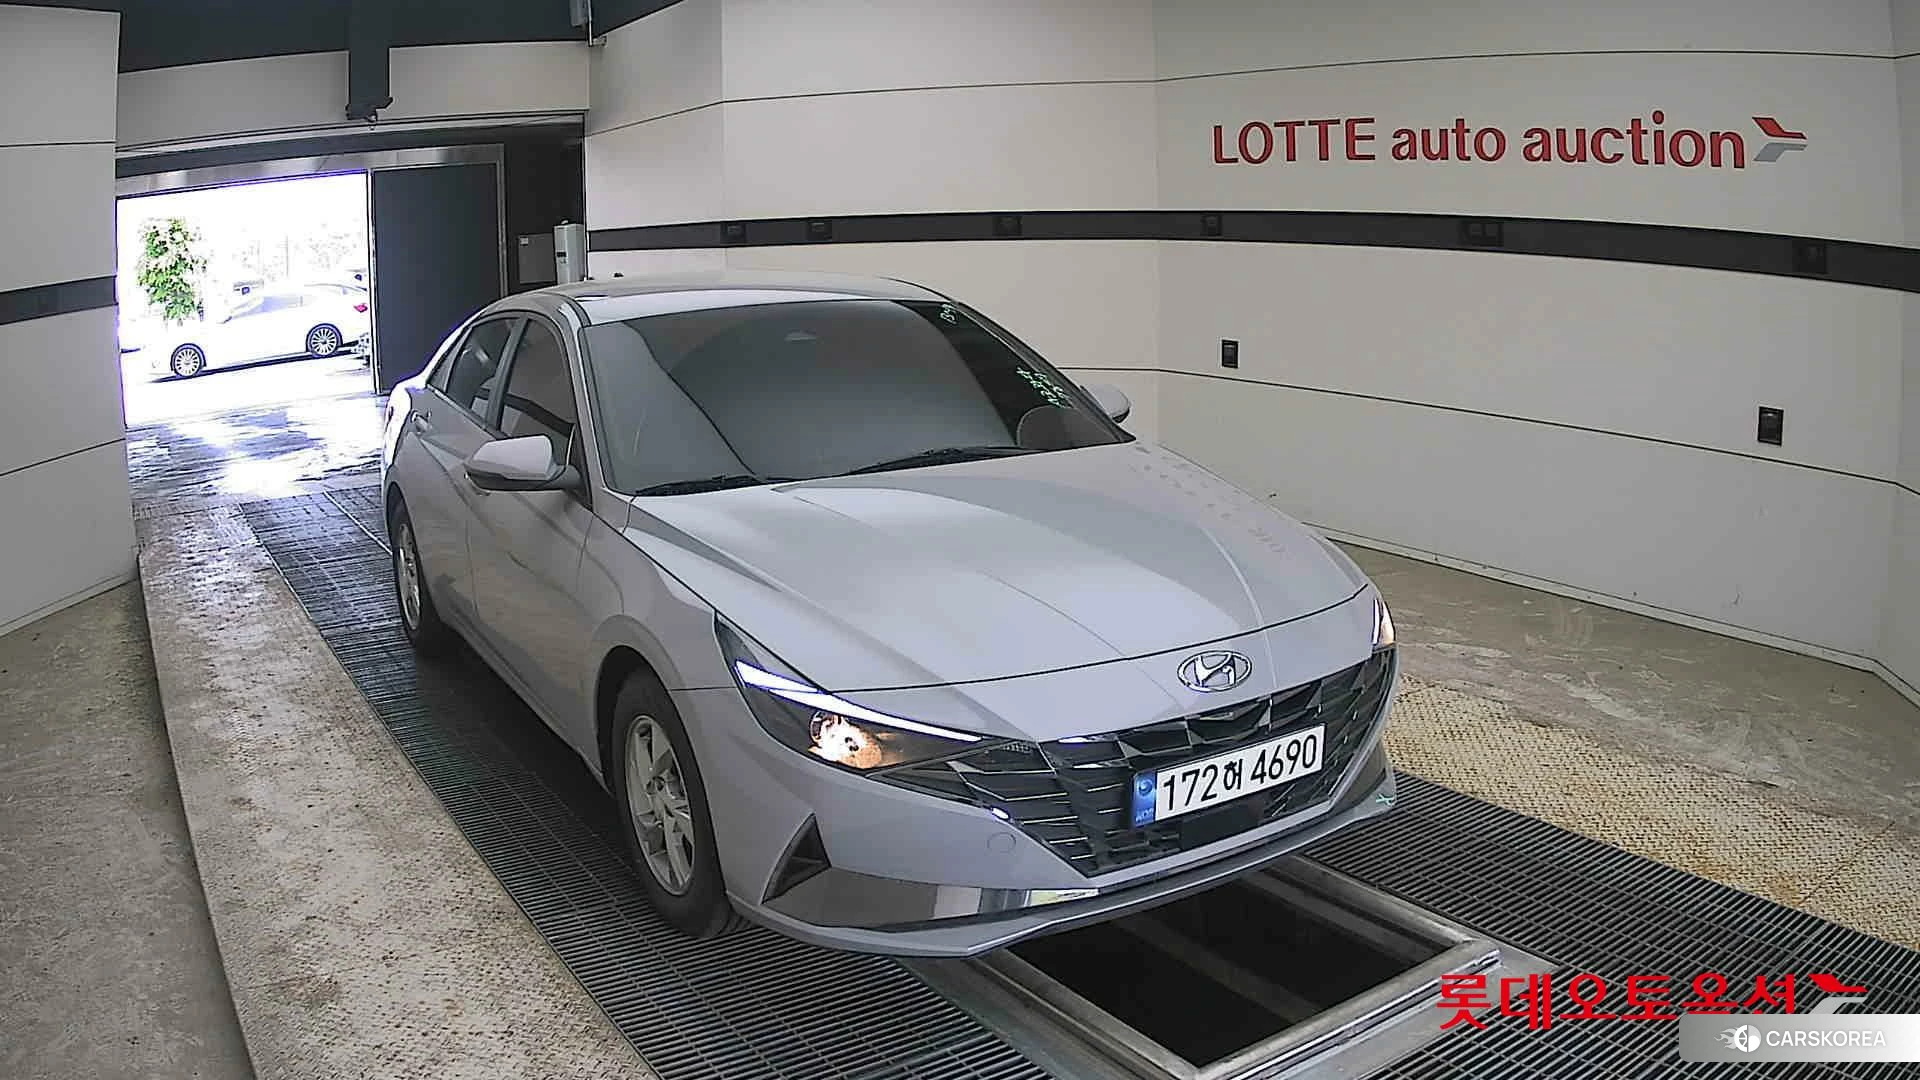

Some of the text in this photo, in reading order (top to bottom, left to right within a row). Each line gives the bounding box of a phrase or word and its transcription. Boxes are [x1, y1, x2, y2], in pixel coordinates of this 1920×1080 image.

[1213, 110, 1746, 169] LOTTE auto auction
[1162, 733, 1318, 811] 172허 4690
